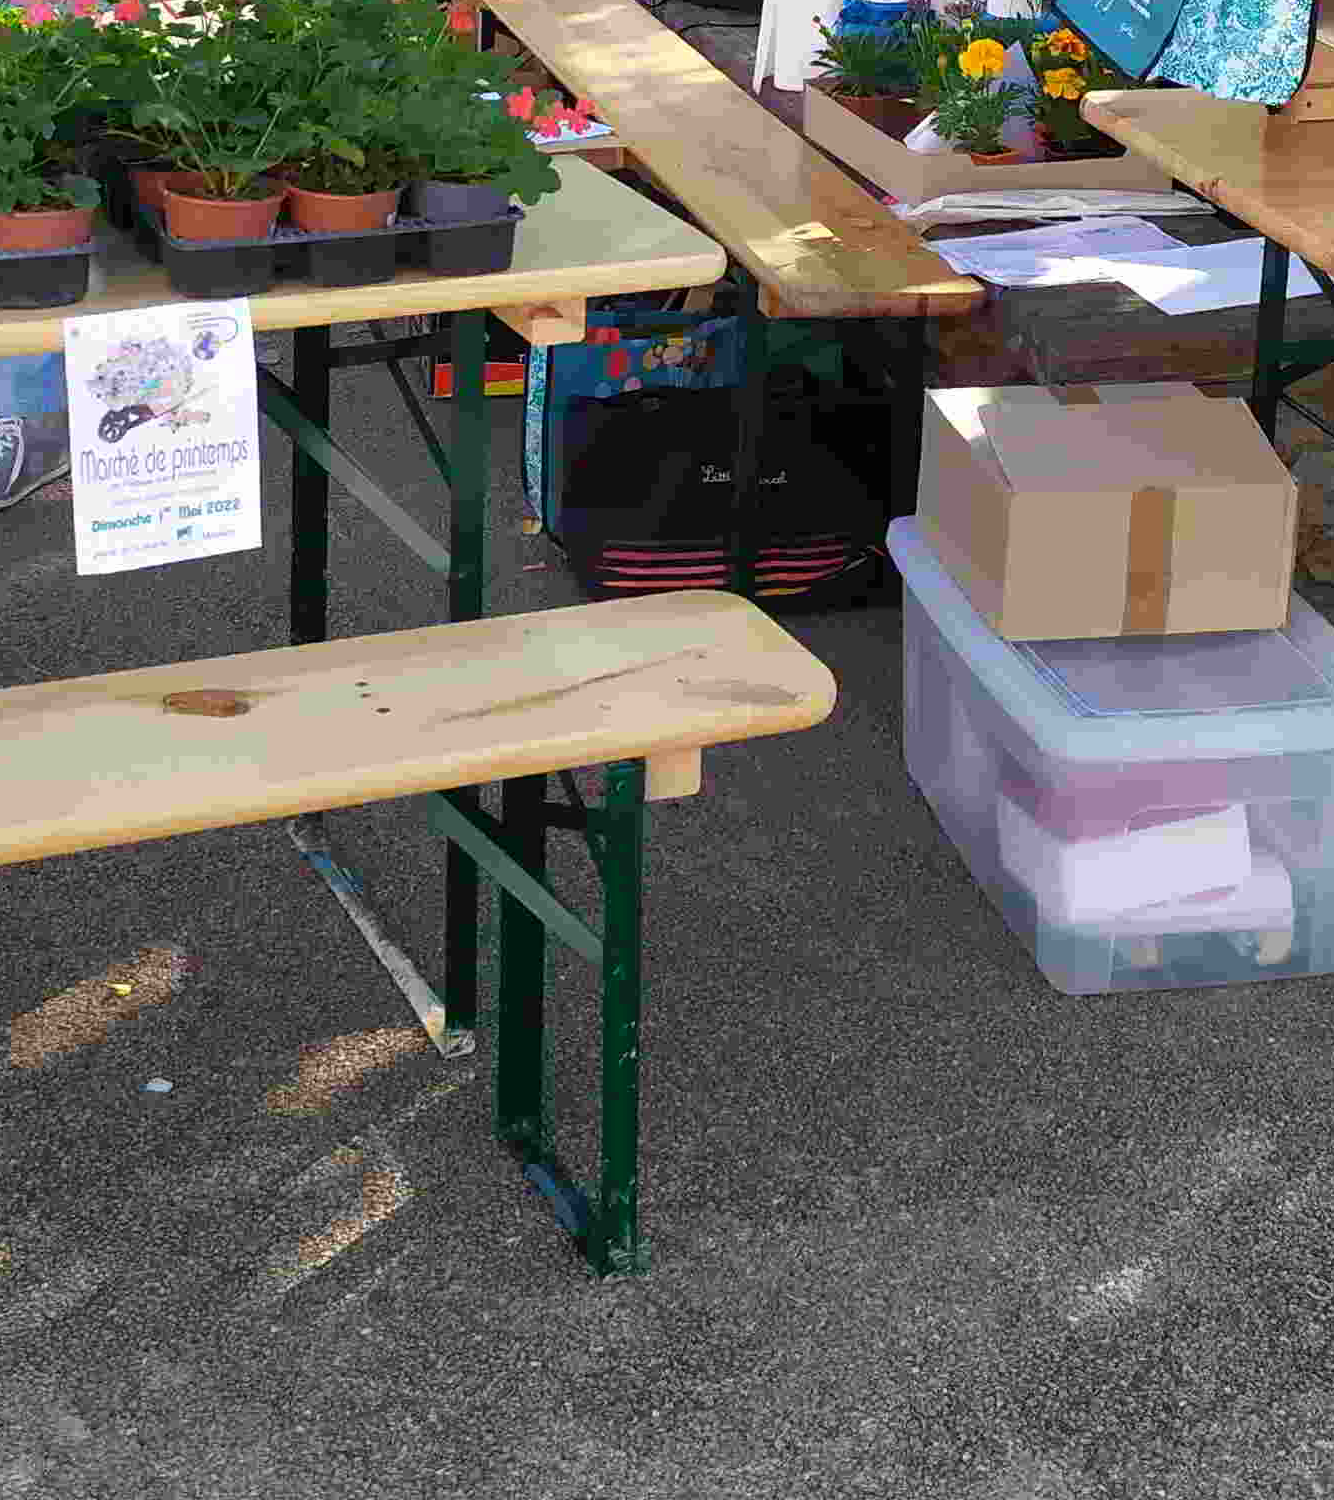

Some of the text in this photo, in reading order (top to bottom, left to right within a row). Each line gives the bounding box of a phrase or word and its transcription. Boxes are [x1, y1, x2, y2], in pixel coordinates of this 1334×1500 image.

[80, 438, 249, 485] Marché de printemps
[91, 512, 153, 533] Dimanche
[206, 498, 242, 516] 2022
